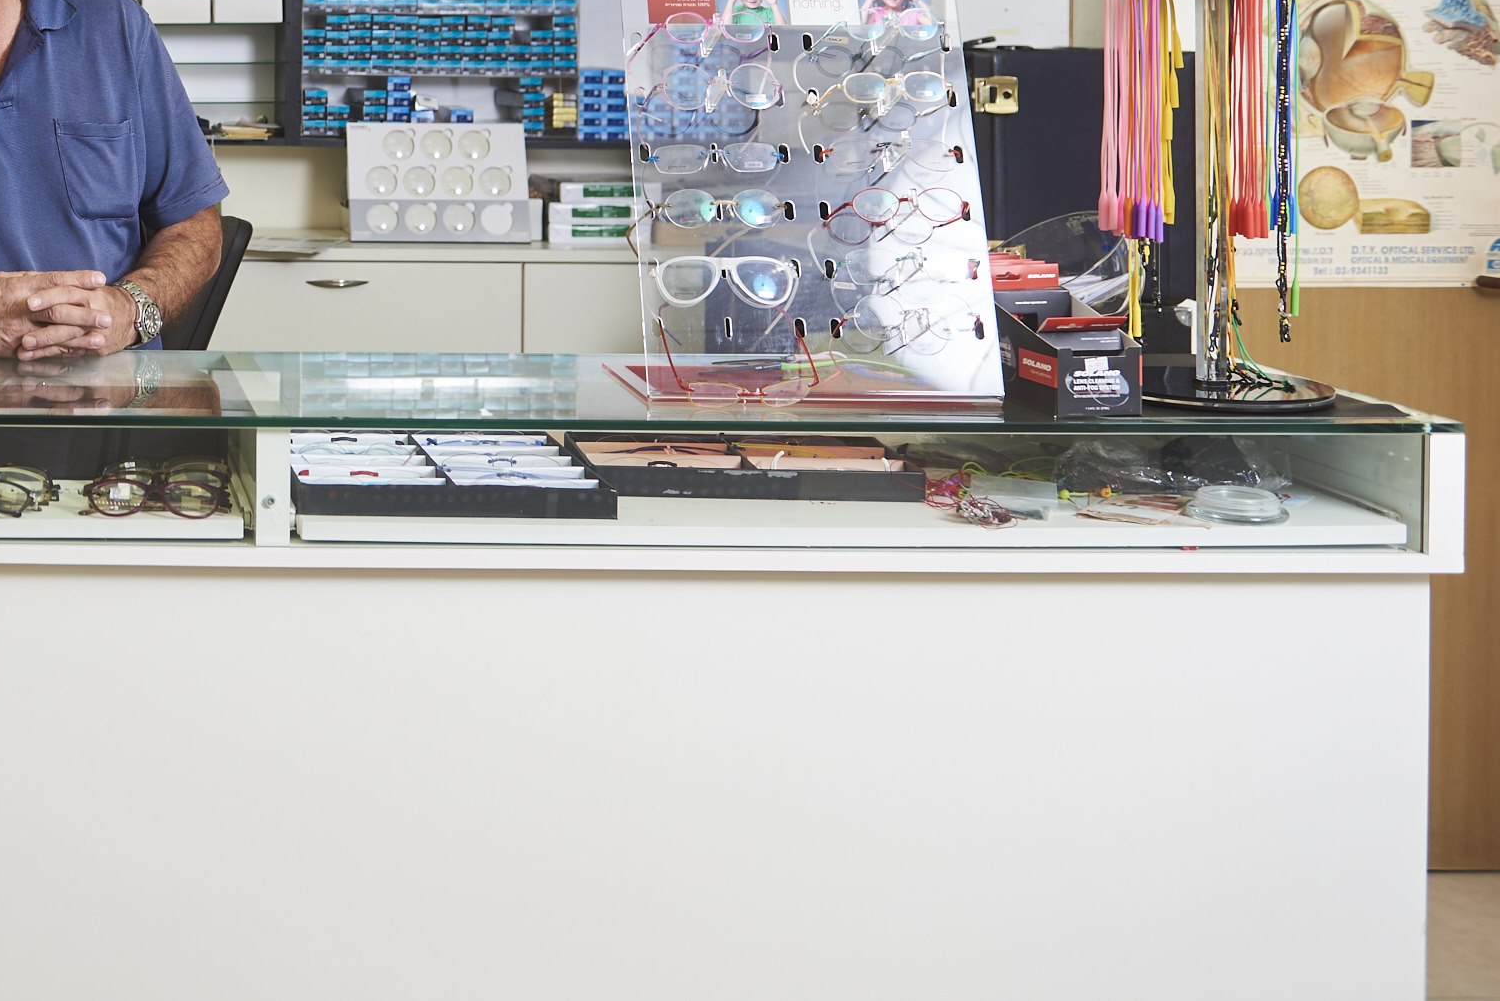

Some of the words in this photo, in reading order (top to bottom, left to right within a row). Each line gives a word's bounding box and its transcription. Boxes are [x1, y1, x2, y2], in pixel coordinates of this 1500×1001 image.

[1351, 246, 1378, 255] D.T.Y.
[1380, 246, 1419, 255] OPTICAL
[1421, 246, 1458, 255] SERVICE
[1350, 256, 1382, 264] OPTICAL
[1392, 256, 1425, 264] MEDICAL
[1426, 256, 1469, 264] EQUIPMENT
[1022, 357, 1052, 372] SOLANO
[1073, 370, 1120, 378] SOLANO
